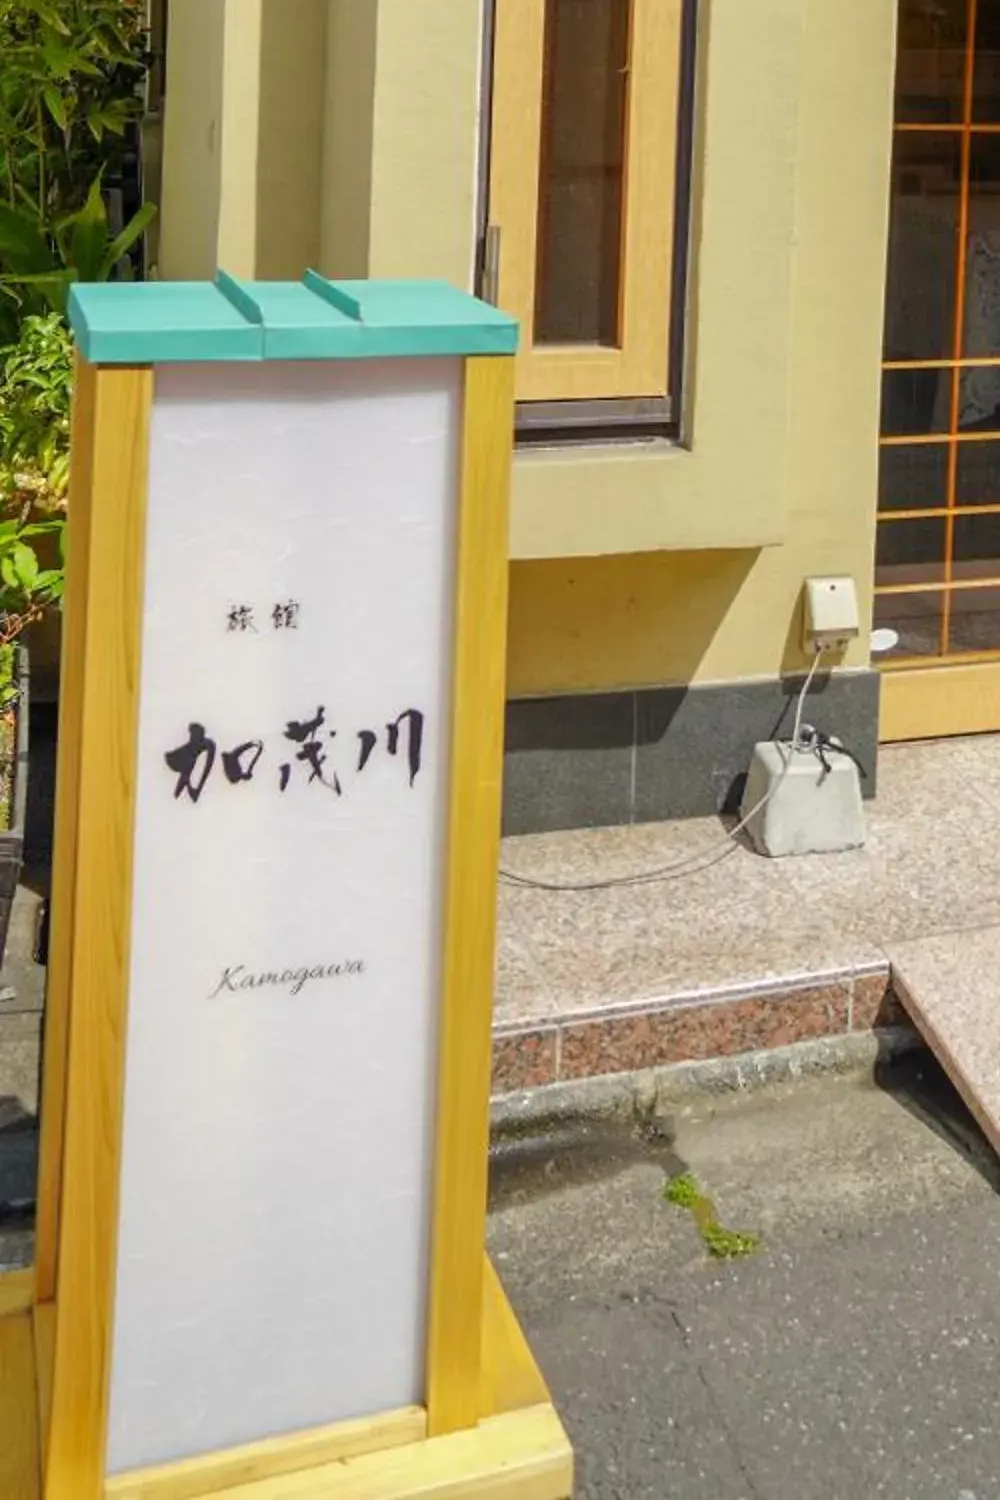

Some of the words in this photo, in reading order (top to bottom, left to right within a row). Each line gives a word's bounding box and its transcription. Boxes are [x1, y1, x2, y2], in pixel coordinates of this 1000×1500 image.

[225, 598, 301, 634] 旅館
[164, 705, 425, 804] 加茂川
[206, 957, 366, 999] Kamogawa
